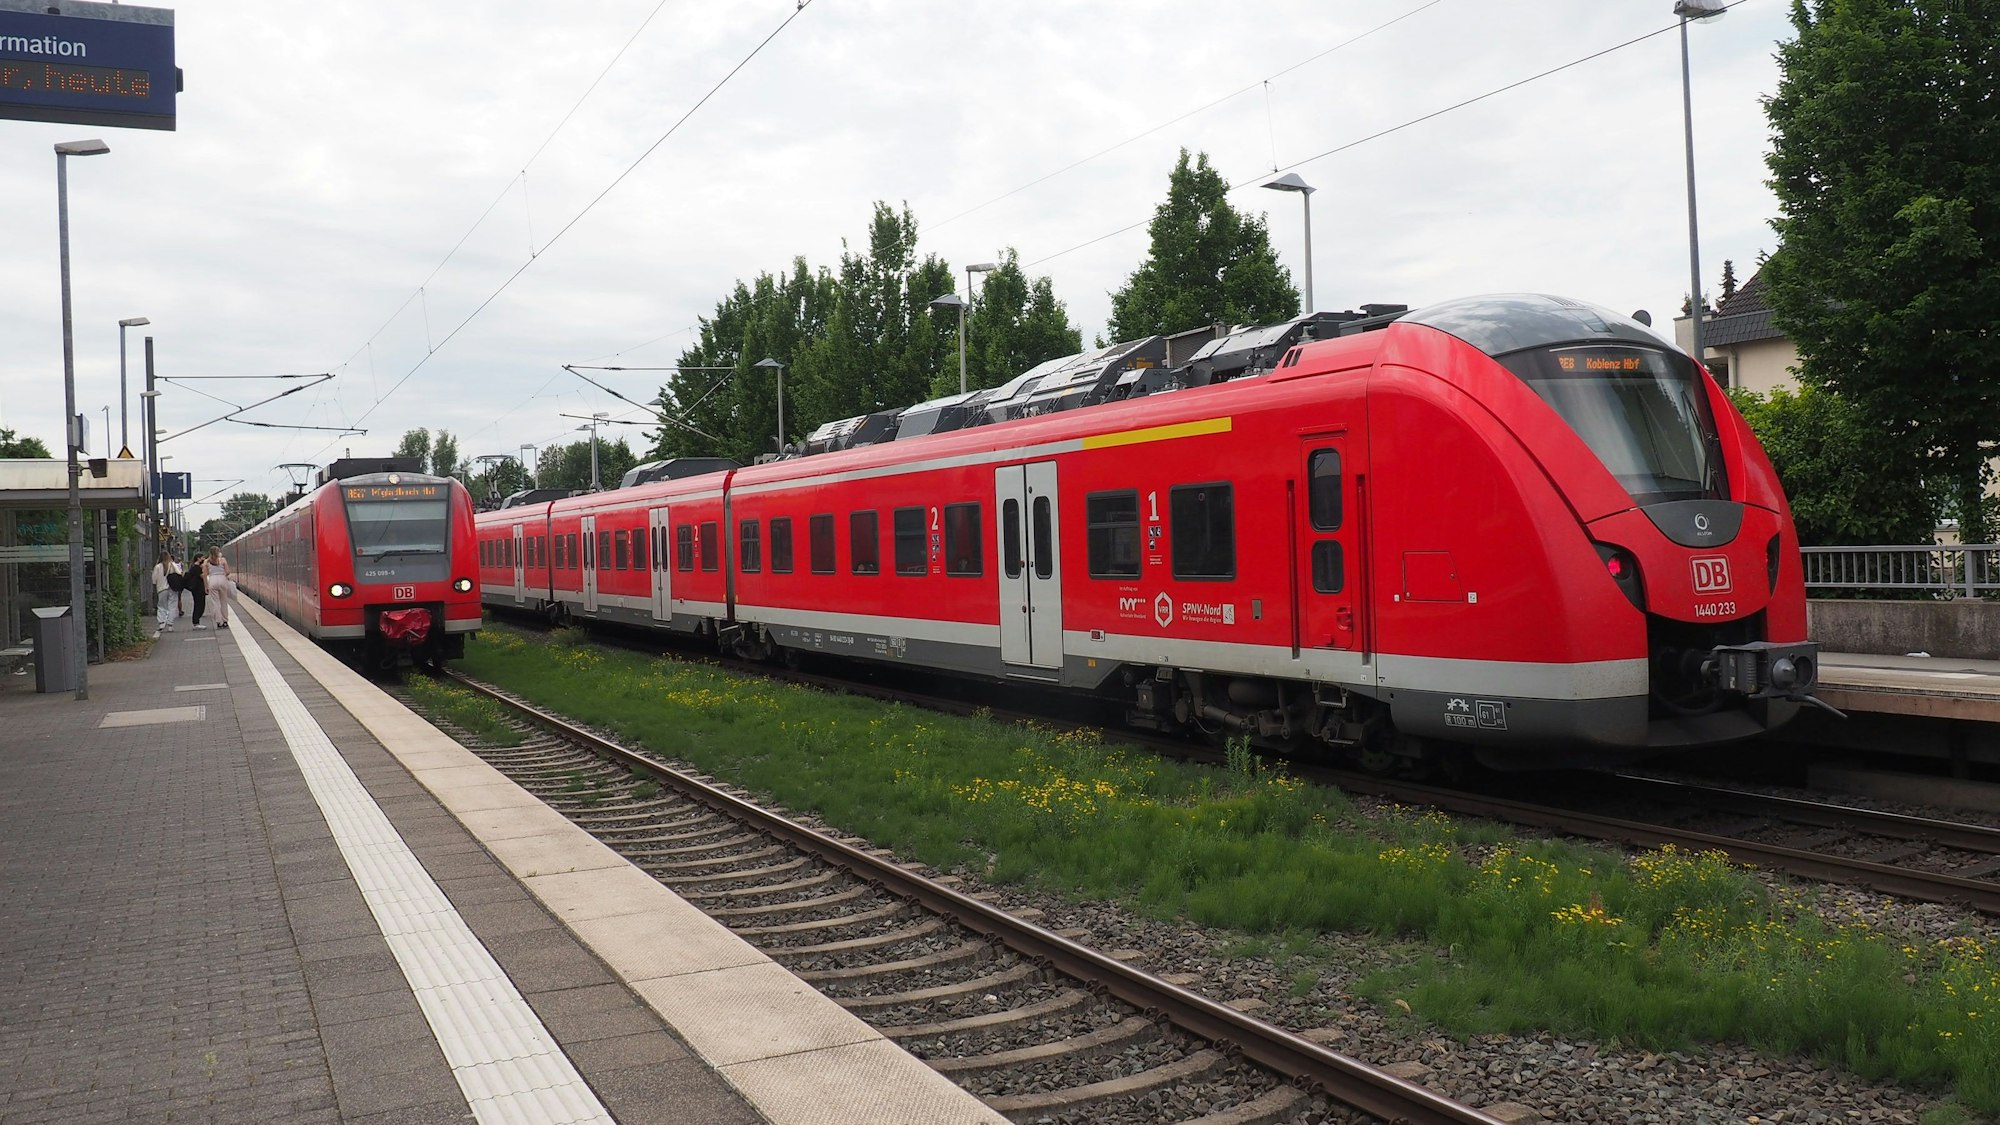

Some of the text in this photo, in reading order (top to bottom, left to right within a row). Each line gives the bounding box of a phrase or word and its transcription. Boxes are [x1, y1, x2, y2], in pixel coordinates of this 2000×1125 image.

[45, 64, 150, 96] heute
[1586, 358, 1621, 369] Koblenz
[1623, 358, 1640, 369] Hbf
[178, 473, 188, 494] 1
[1148, 491, 1160, 521] 1
[931, 506, 939, 531] 2
[694, 525, 699, 542] 2
[1694, 560, 1729, 590] DB
[394, 586, 414, 599] DB
[1158, 605, 1169, 614] VRR
[1182, 602, 1222, 616] SPNV-Nord
[1694, 602, 1736, 617] 1440 233
[1446, 715, 1452, 724] R
[1453, 715, 1467, 726] 100
